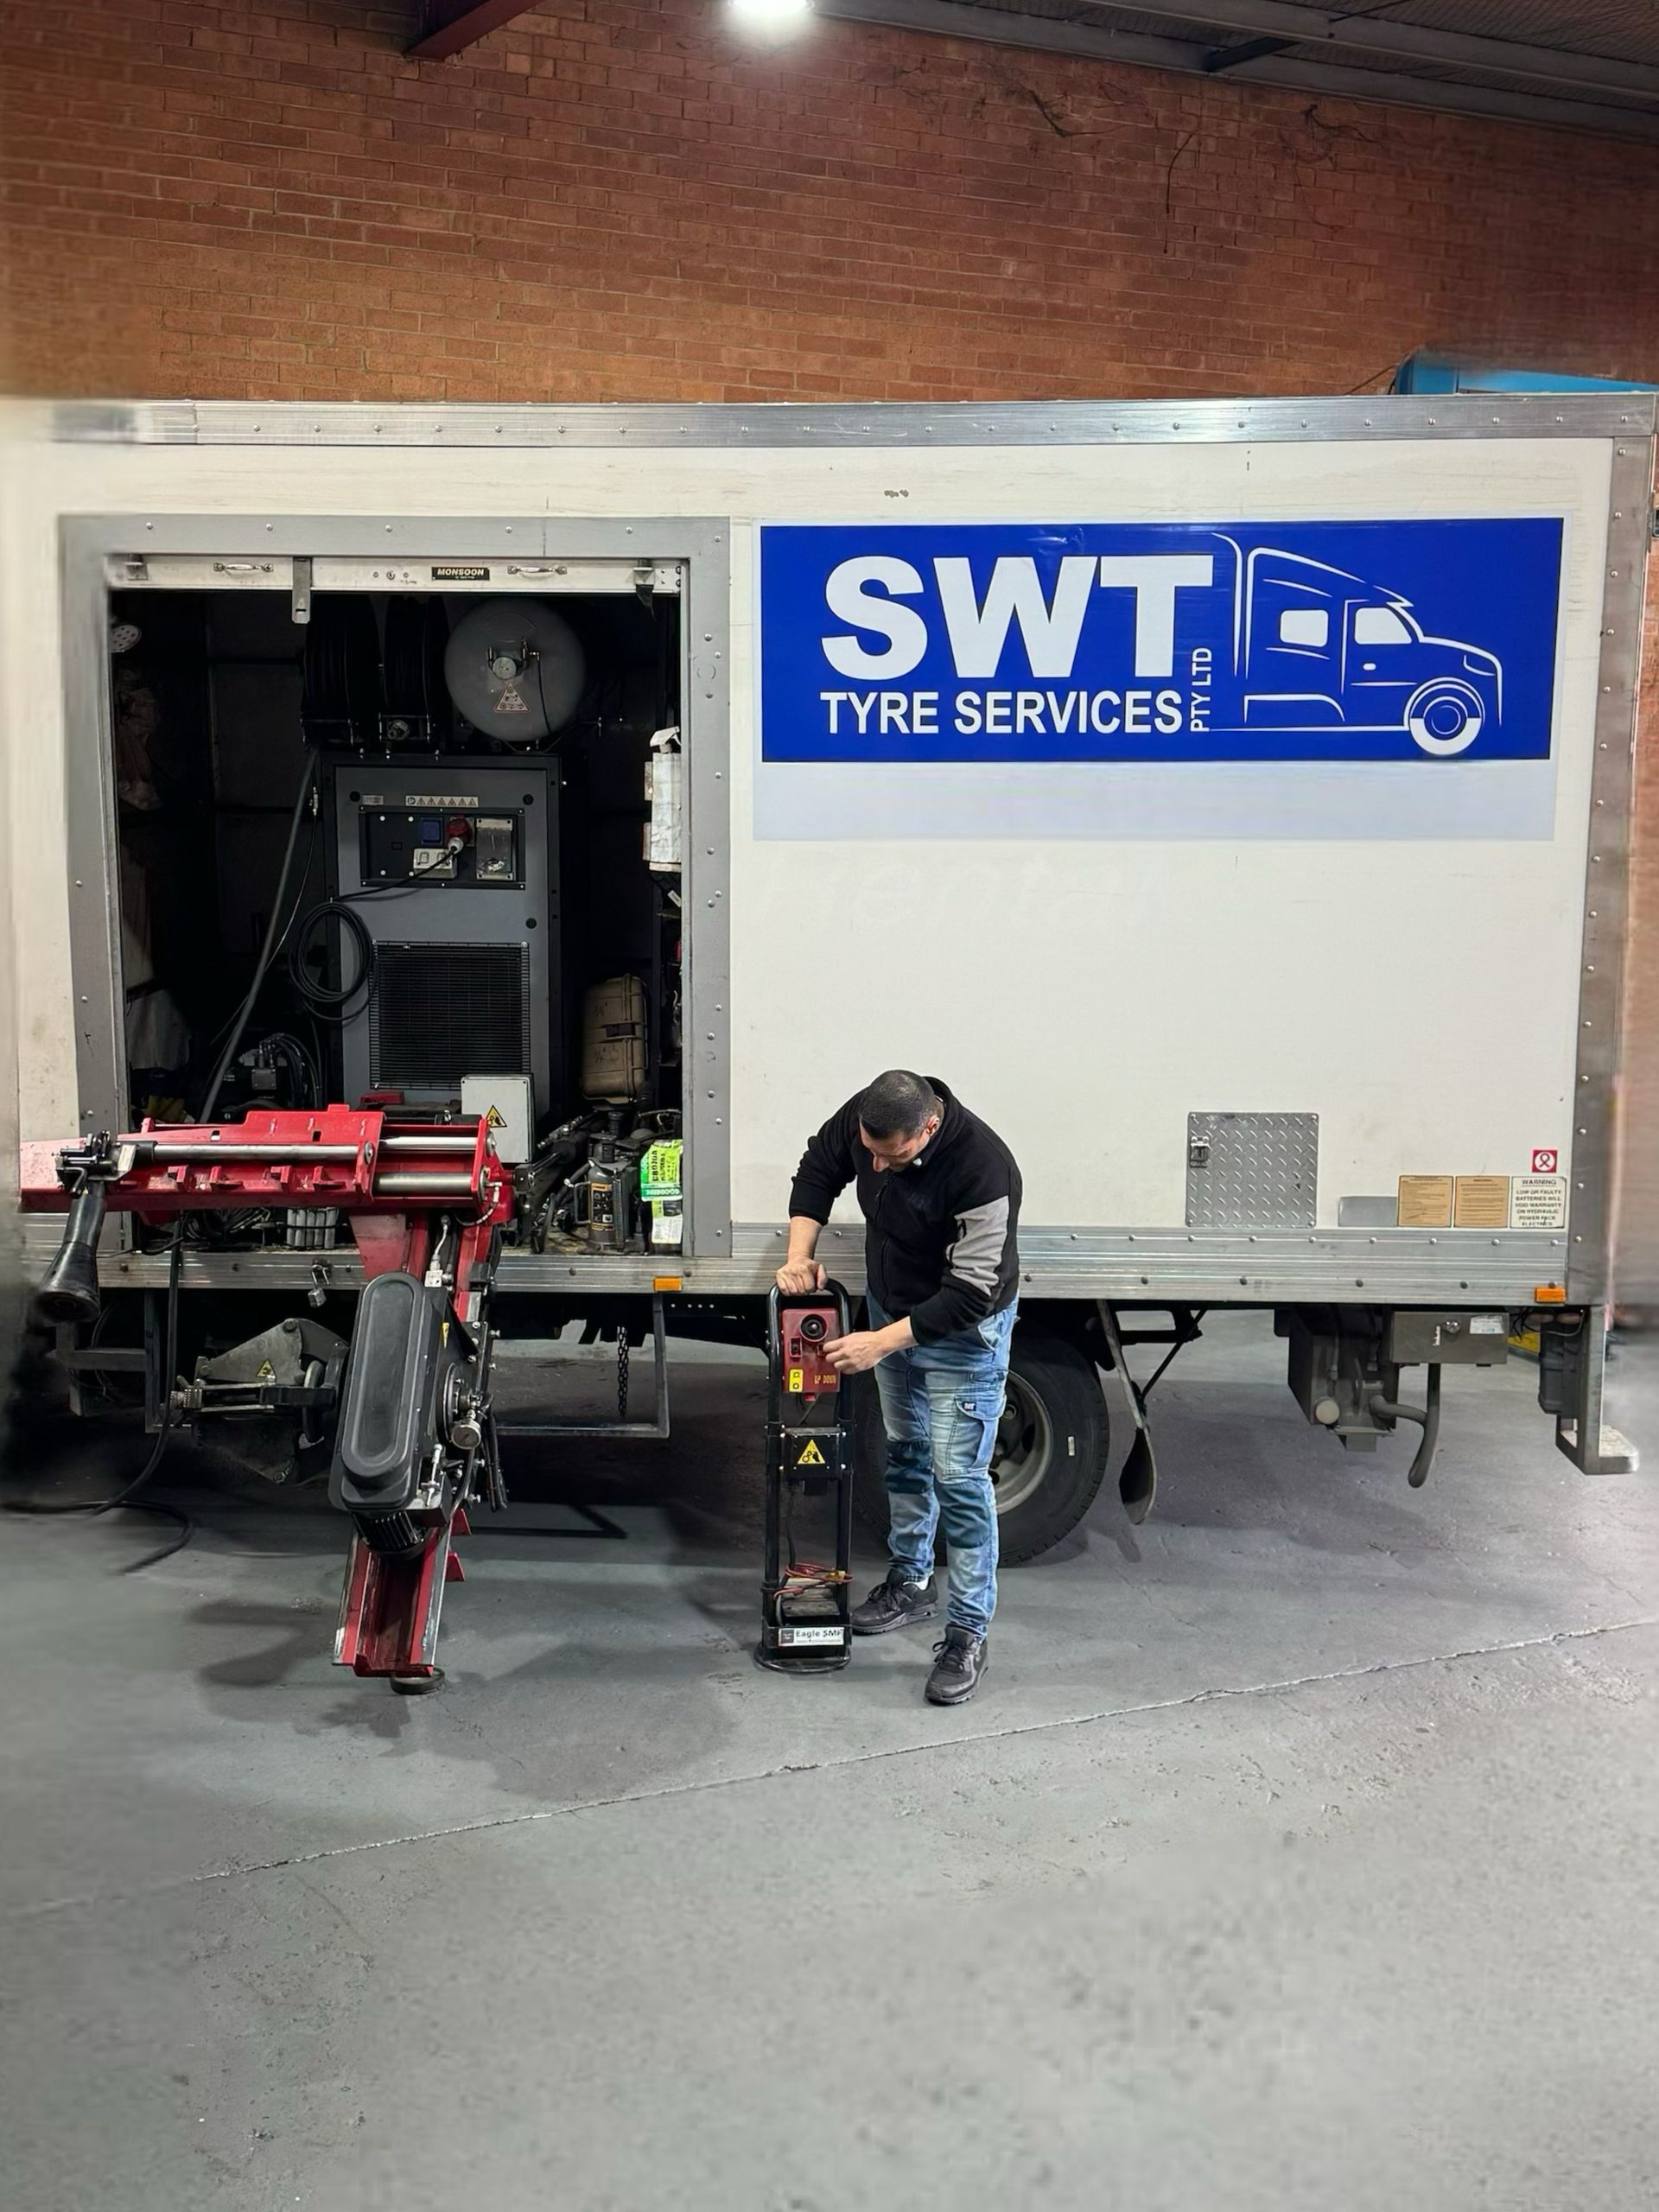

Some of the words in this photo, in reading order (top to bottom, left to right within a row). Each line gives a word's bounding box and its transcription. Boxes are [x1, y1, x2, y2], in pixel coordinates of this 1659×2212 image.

[821, 555, 1214, 681] SWT
[1192, 647, 1212, 687] LTD
[820, 690, 939, 734] TYRE
[954, 690, 1183, 734] SERVICES
[1191, 691, 1211, 733] PTY
[814, 1375, 822, 1384] UP
